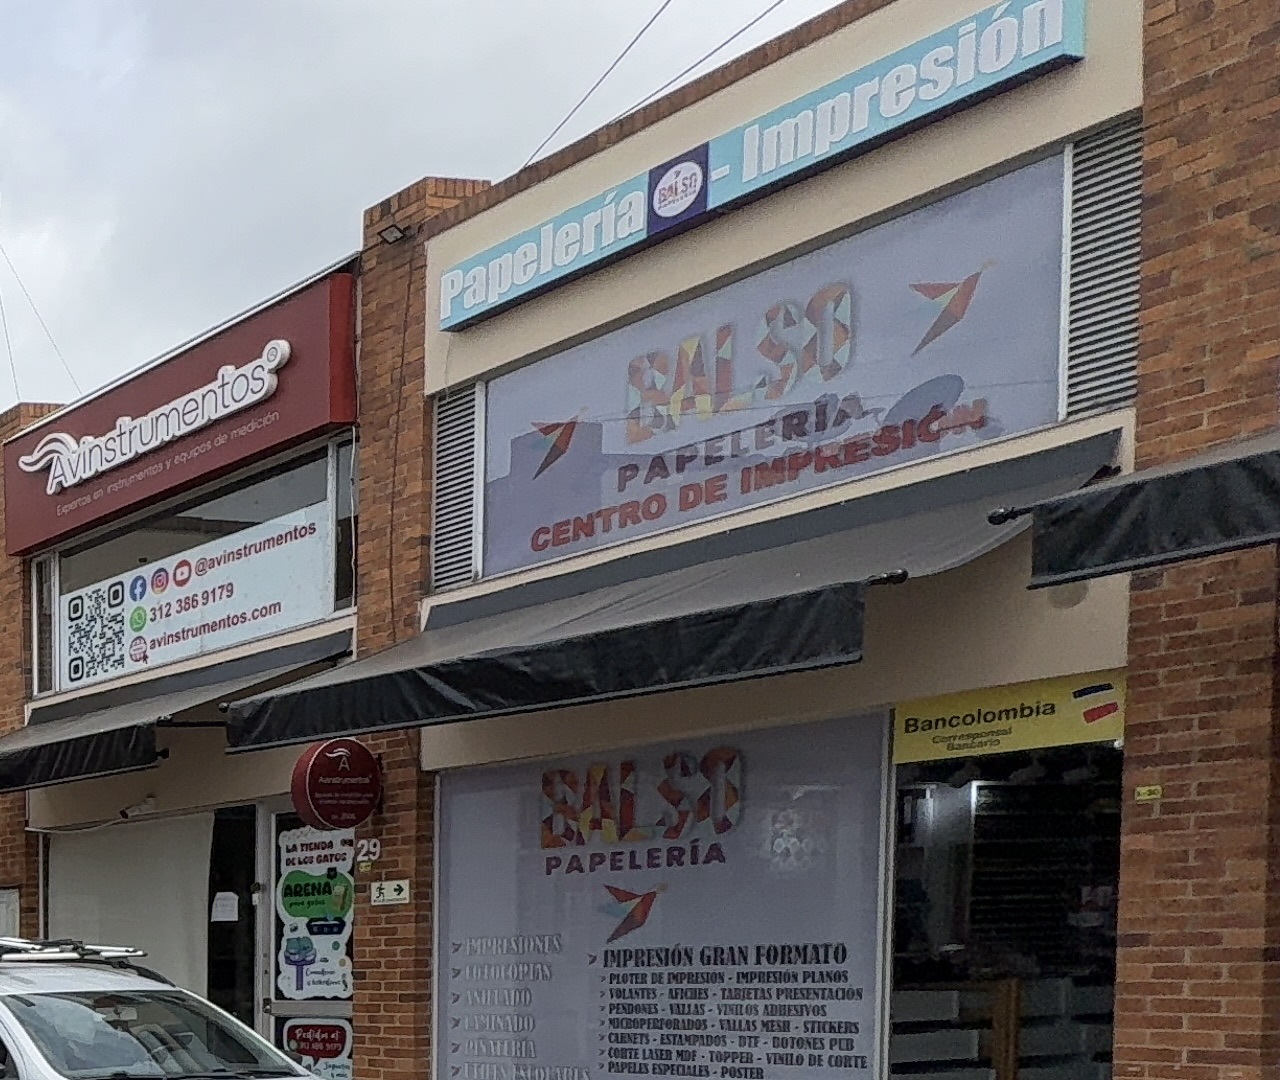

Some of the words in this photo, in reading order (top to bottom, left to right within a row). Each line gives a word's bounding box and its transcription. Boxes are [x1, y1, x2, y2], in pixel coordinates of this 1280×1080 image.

[441, 186, 644, 322] Papelería
[743, 0, 1063, 182] Impresión
[49, 364, 268, 489] Avinstrumentos
[530, 487, 667, 553] CENTRO
[679, 474, 728, 512] DE
[195, 522, 317, 577] @avinstrumentos
[150, 601, 177, 622] 312
[176, 595, 199, 614] 386
[201, 582, 234, 606] 9179
[149, 601, 282, 650] avinstrumentos.com
[904, 701, 1056, 734] Bancolombia
[541, 745, 741, 849] BALSO
[356, 838, 381, 861] 29
[545, 838, 726, 875] PAPELERÍA
[283, 881, 333, 898] ARENA
[603, 943, 694, 967] IMPRESIÓN
[700, 944, 749, 967] GRAN
[754, 942, 847, 966] FORMATO
[609, 972, 648, 985] PLOTER
[802, 970, 849, 983] PLANOS
[609, 988, 657, 1000] VOLANTES
[660, 1033, 727, 1047] ESTAMPADOS
[803, 1021, 859, 1034] STICKERS
[608, 1061, 649, 1074] PAPELES
[720, 1066, 764, 1079] POSTER
[709, 1050, 754, 1063] TOPPER
[808, 1053, 824, 1067] DE
[827, 1054, 867, 1069] CORTE
